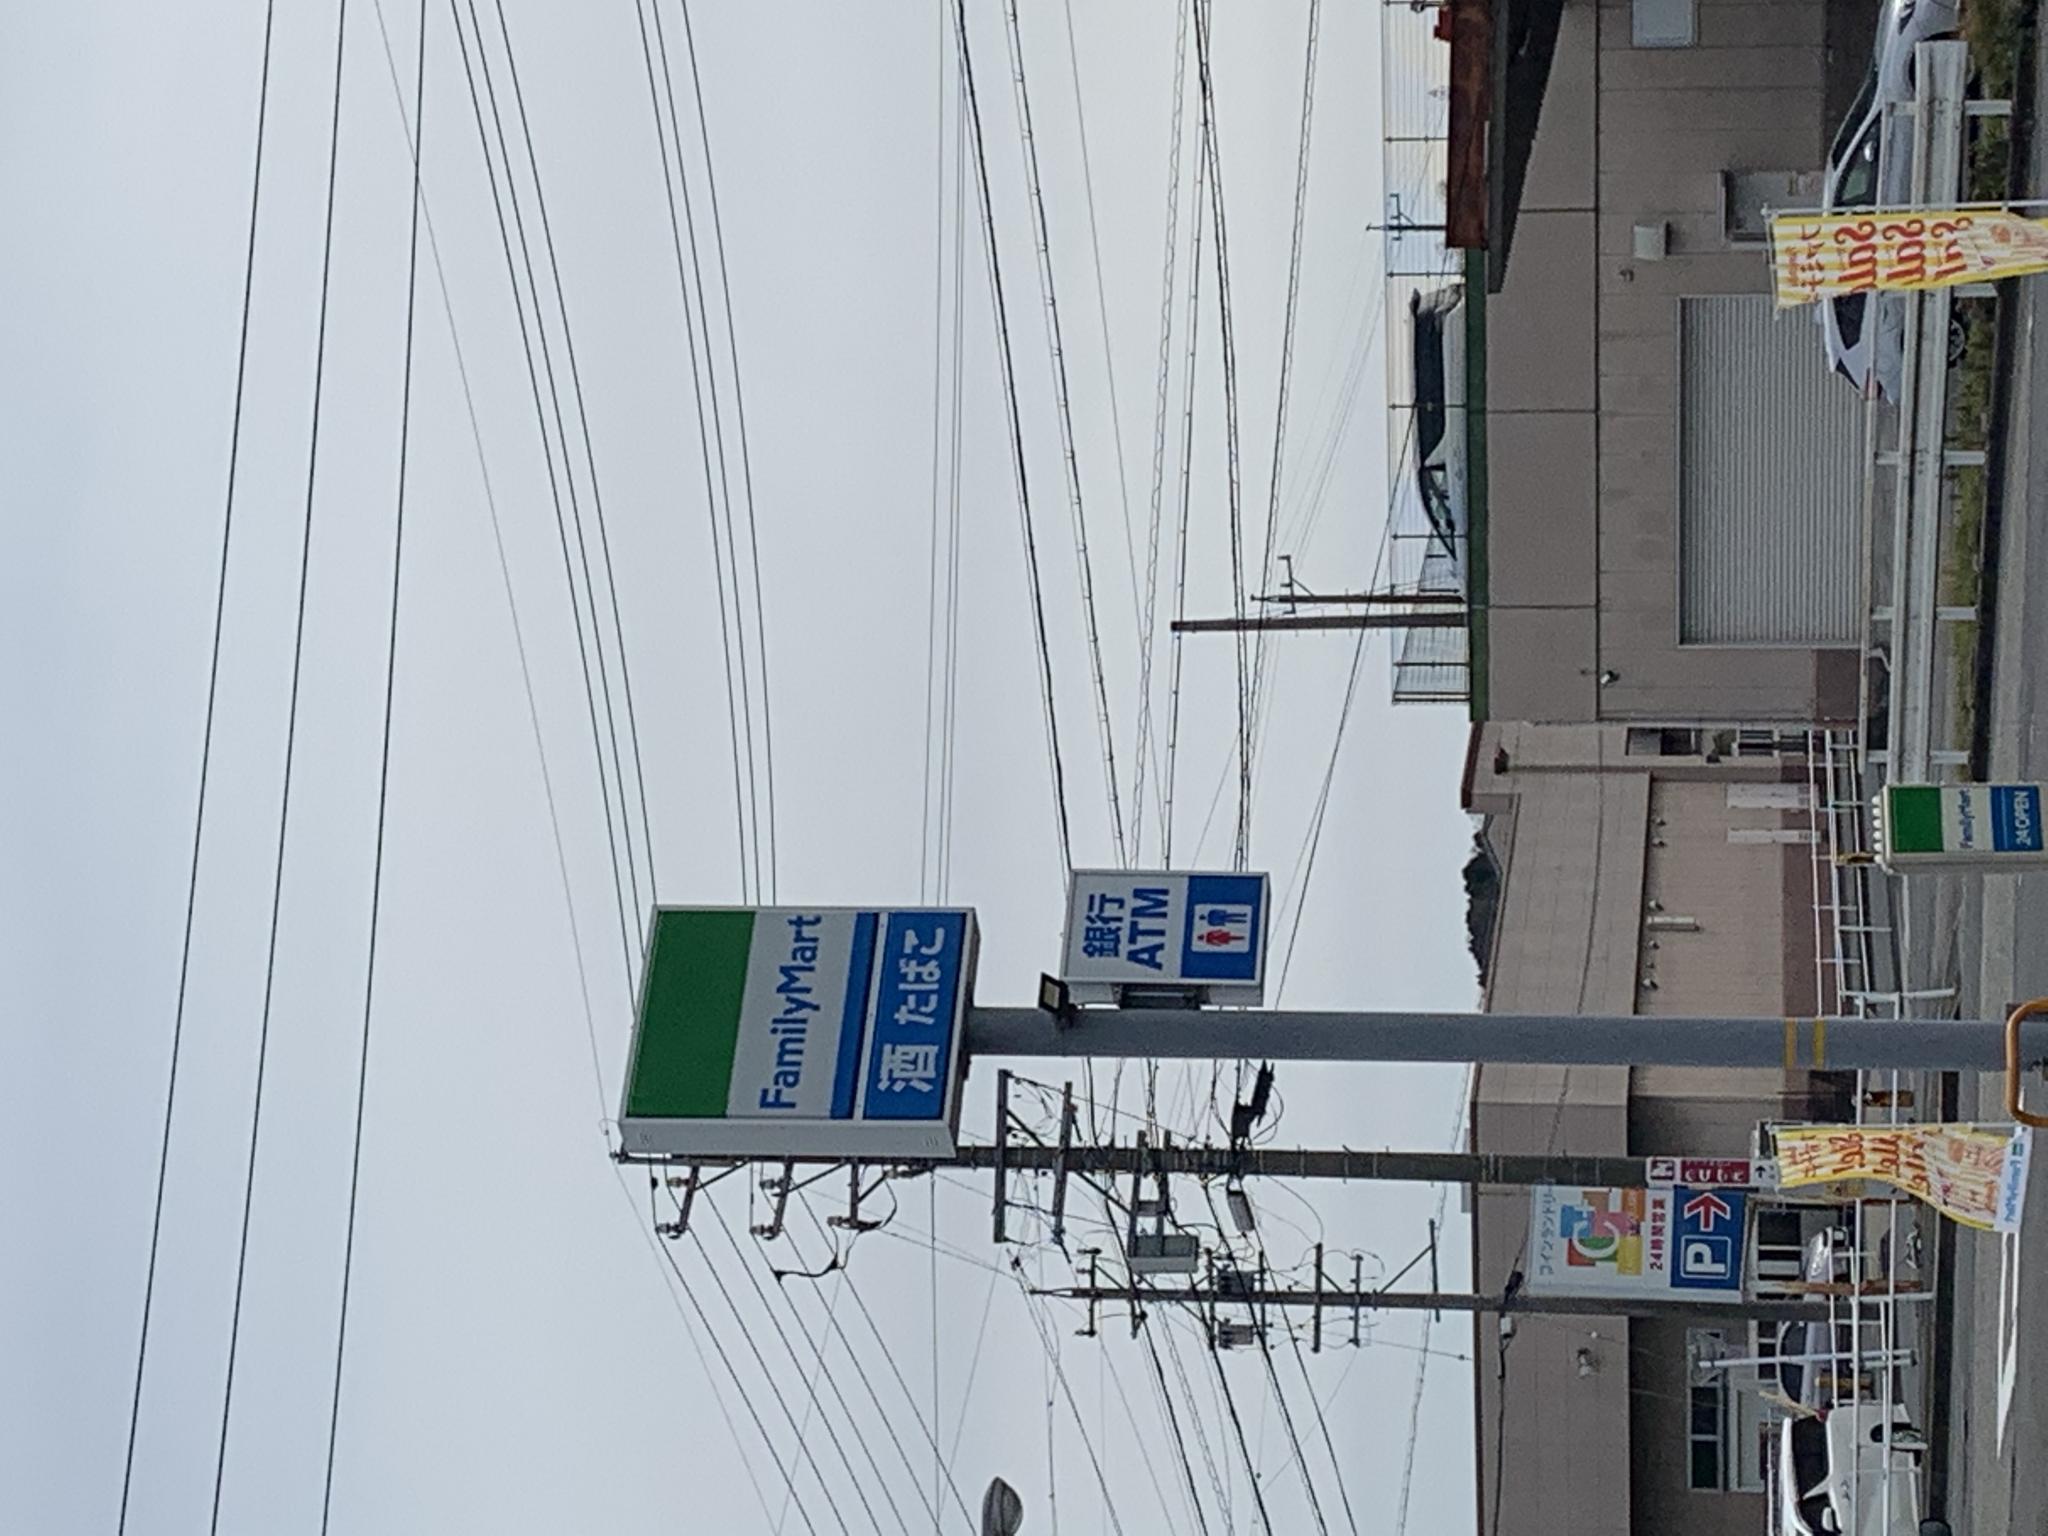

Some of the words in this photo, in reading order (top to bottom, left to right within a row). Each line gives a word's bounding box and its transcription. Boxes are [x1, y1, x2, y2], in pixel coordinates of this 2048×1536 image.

[1956, 789, 1976, 848] FamilyMart
[1082, 894, 1125, 958] 銀行
[1127, 888, 1170, 970] ATM
[894, 927, 945, 1025] たばこ
[759, 915, 821, 1109] FamilyMart
[877, 1042, 939, 1093] 酒
[1686, 1242, 1726, 1273] P
